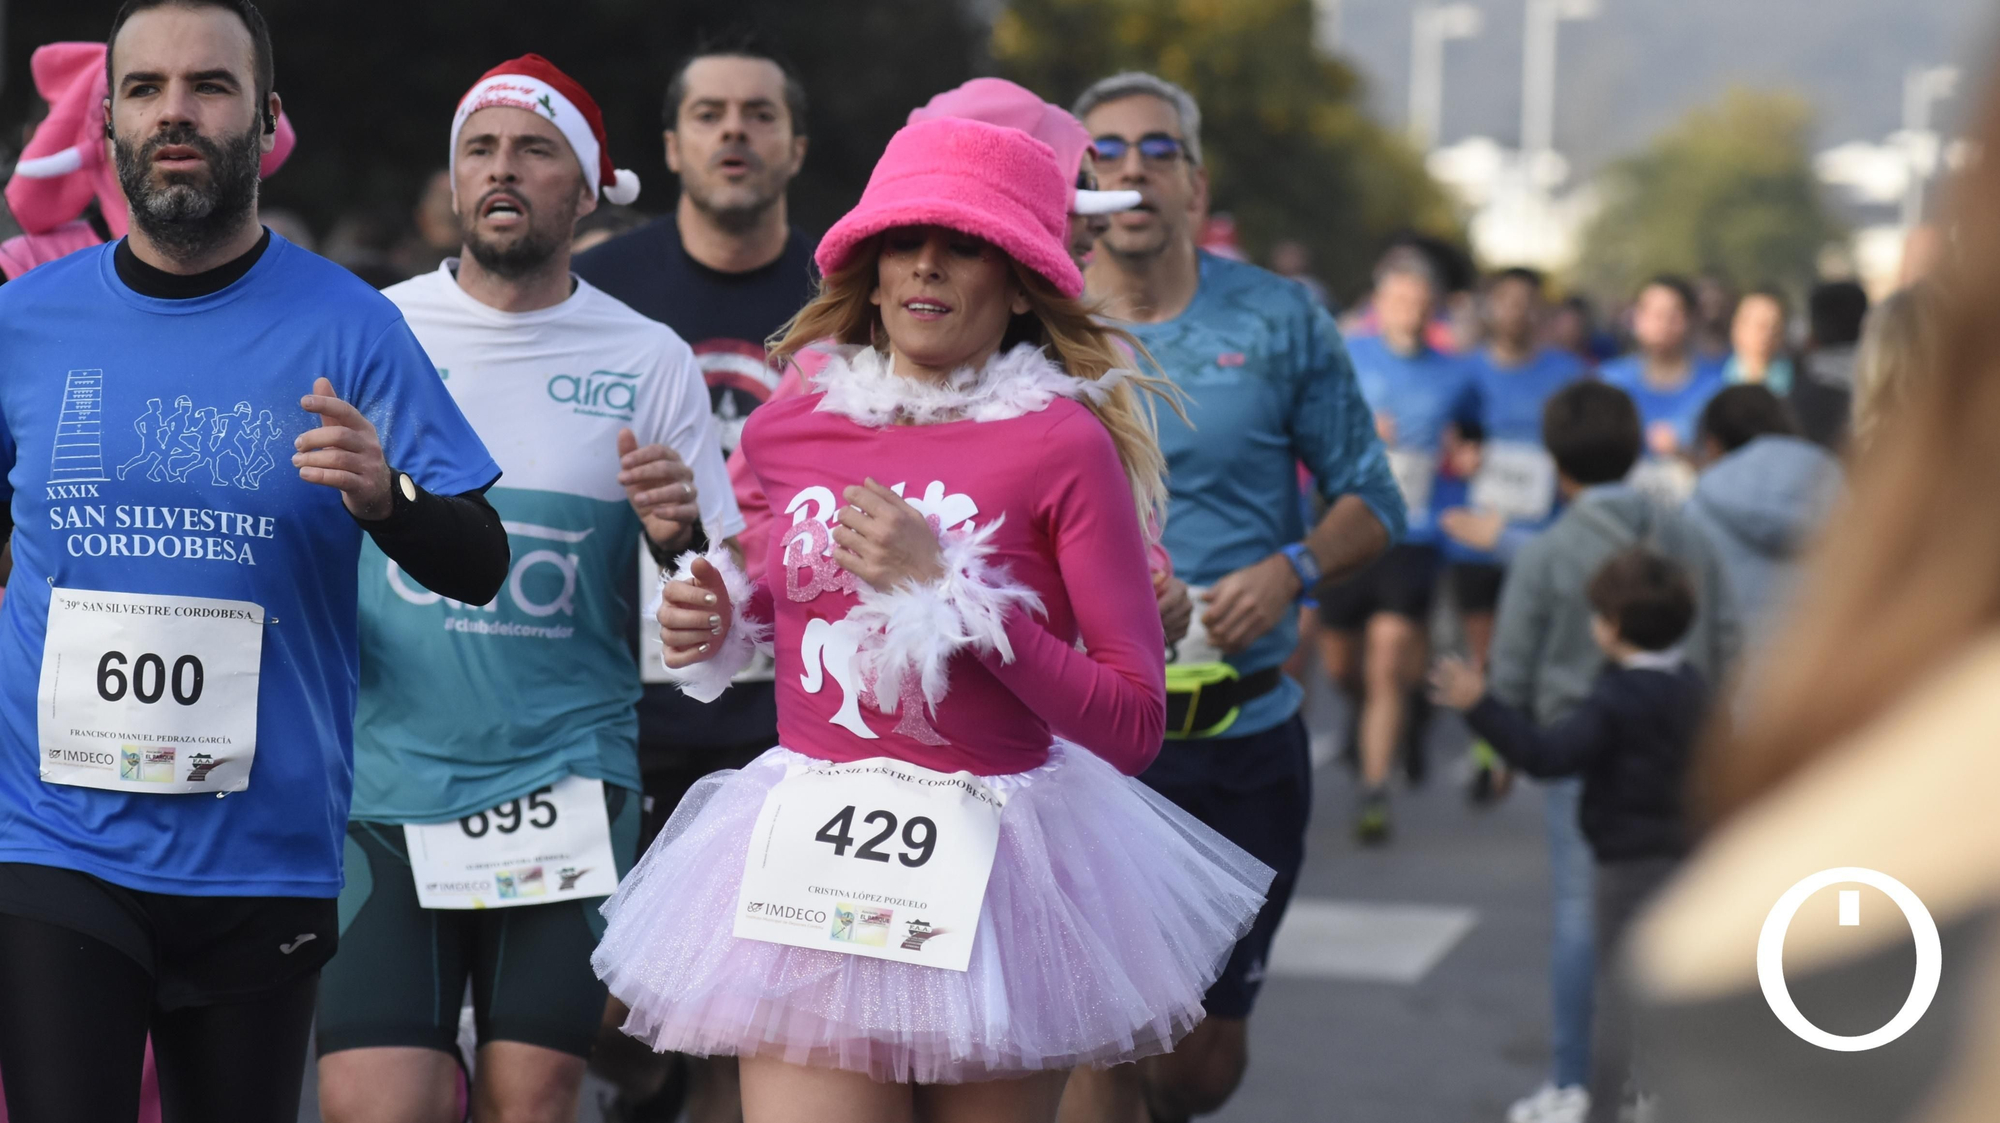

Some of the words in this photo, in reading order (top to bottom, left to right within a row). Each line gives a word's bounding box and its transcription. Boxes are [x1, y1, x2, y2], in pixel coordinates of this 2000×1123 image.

[547, 369, 643, 412] aira
[46, 484, 100, 500] XXXIX
[50, 505, 107, 530] SAN
[115, 505, 275, 539] SILVESTRE
[67, 533, 257, 565] CORDOBESA
[81, 601, 104, 612] SAN
[105, 604, 171, 617] SILVESTRE
[174, 606, 252, 620] CORDOBESA
[444, 615, 577, 640] #clubdelcorredor
[96, 651, 205, 706] 600
[70, 729, 117, 739] FRANCISCO
[117, 732, 155, 742] MANUEL
[156, 735, 196, 744] PEDRAZA
[198, 734, 232, 745] GARCÍA
[63, 749, 114, 766] IMDECO
[815, 767, 844, 777] SAN
[844, 766, 915, 784] SILVESTRE
[918, 777, 995, 807] CORDOBESA
[814, 805, 938, 868] 429
[440, 880, 492, 892] IMDECO
[807, 885, 851, 899] CRISTINA
[852, 889, 883, 904] LÓPEZ
[884, 895, 928, 910] POZUELO
[765, 903, 827, 924] IMDECO
